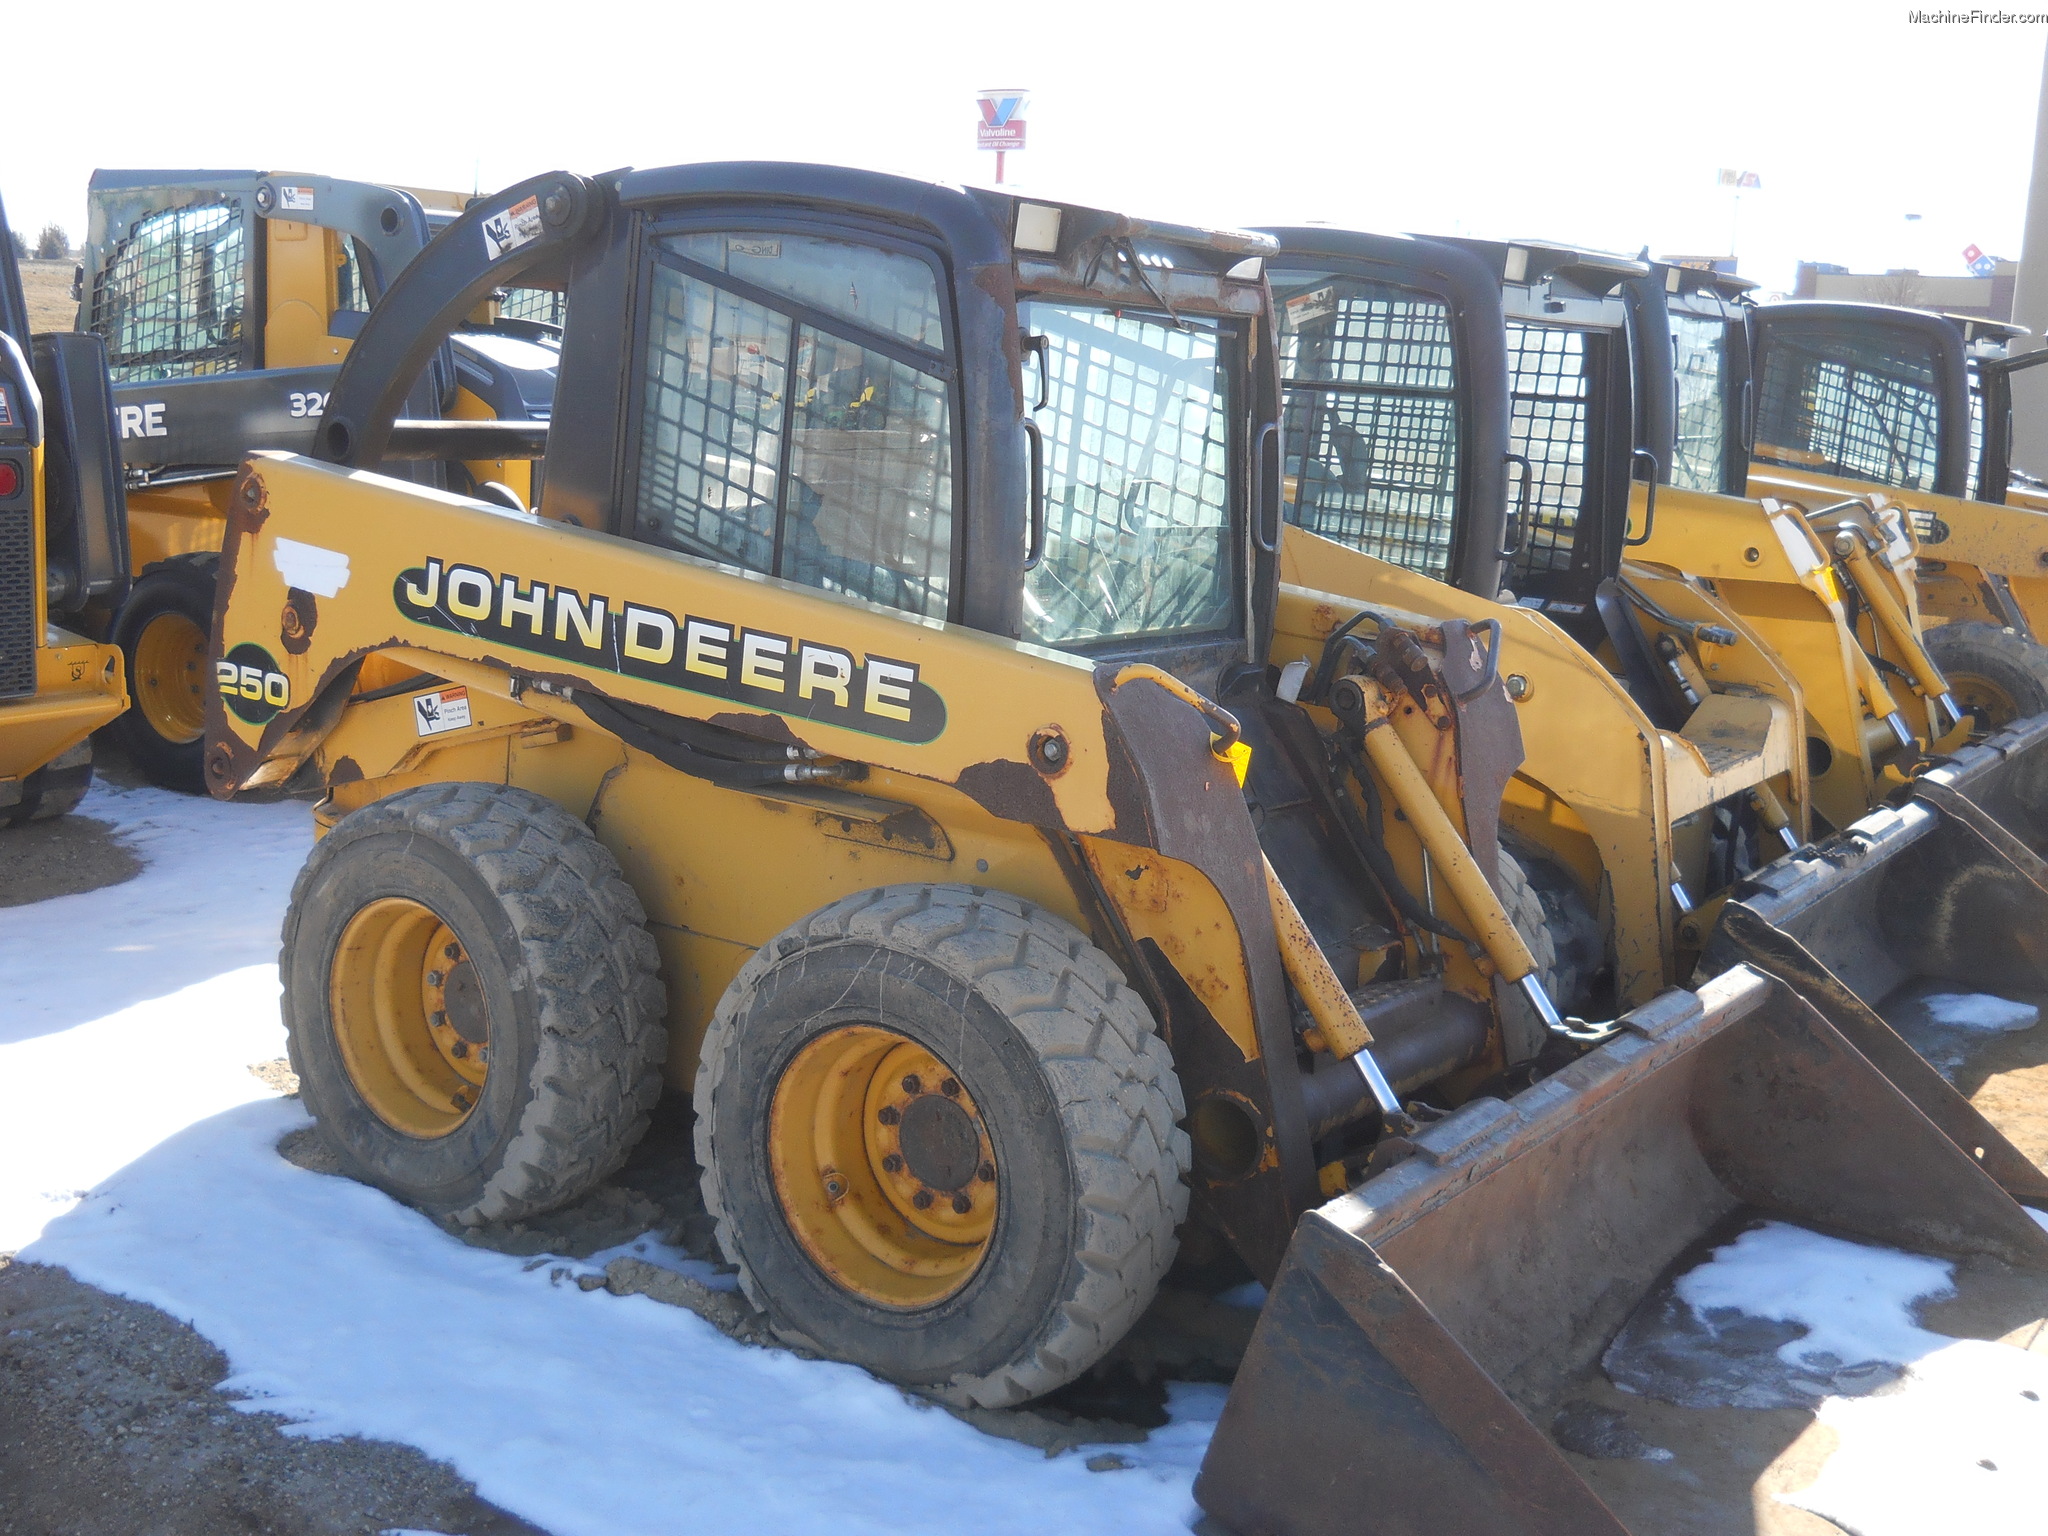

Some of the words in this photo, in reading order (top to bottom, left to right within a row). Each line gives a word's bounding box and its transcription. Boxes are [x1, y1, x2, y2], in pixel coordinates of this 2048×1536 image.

[980, 128, 1016, 137] Valvoline
[115, 403, 167, 438] RE
[290, 392, 331, 417] 32
[406, 562, 605, 650] JOHN
[624, 607, 915, 722] DEERE
[216, 662, 289, 707] 250
